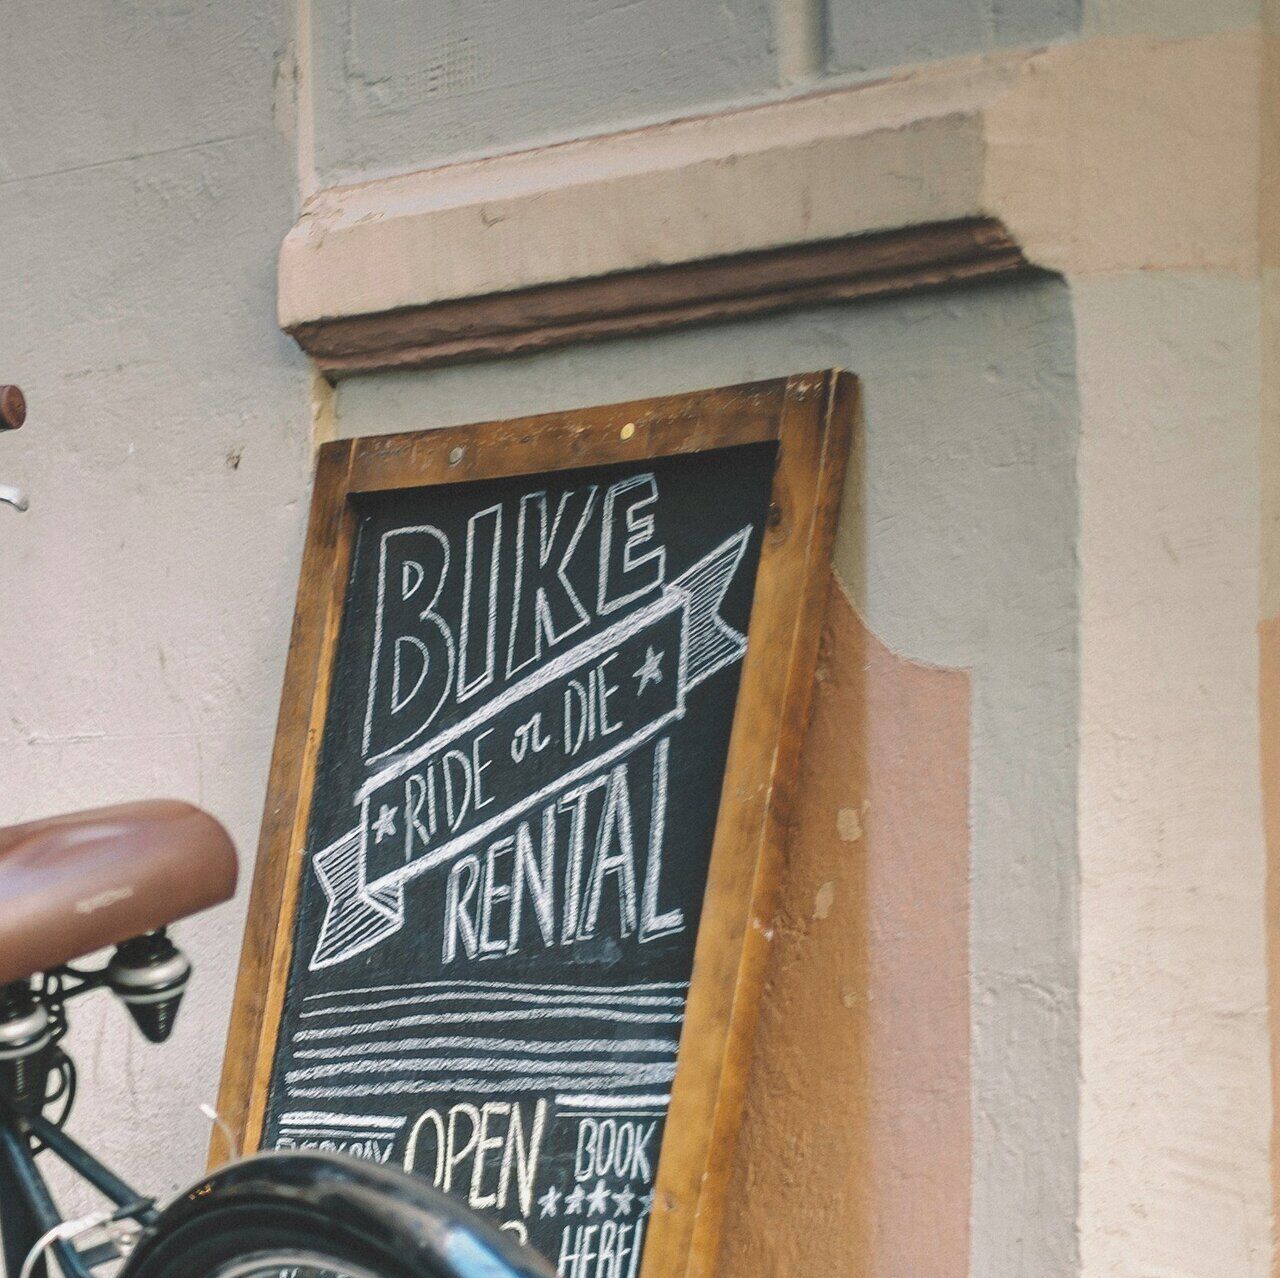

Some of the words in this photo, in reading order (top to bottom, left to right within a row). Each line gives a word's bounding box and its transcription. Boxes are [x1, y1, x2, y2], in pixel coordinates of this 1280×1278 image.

[361, 472, 666, 767] BIKE
[403, 728, 495, 860] RIDE
[563, 653, 624, 757] DIE
[441, 737, 685, 965] RENTAL
[403, 1098, 547, 1219] OPEN
[574, 1117, 657, 1184] BOOK
